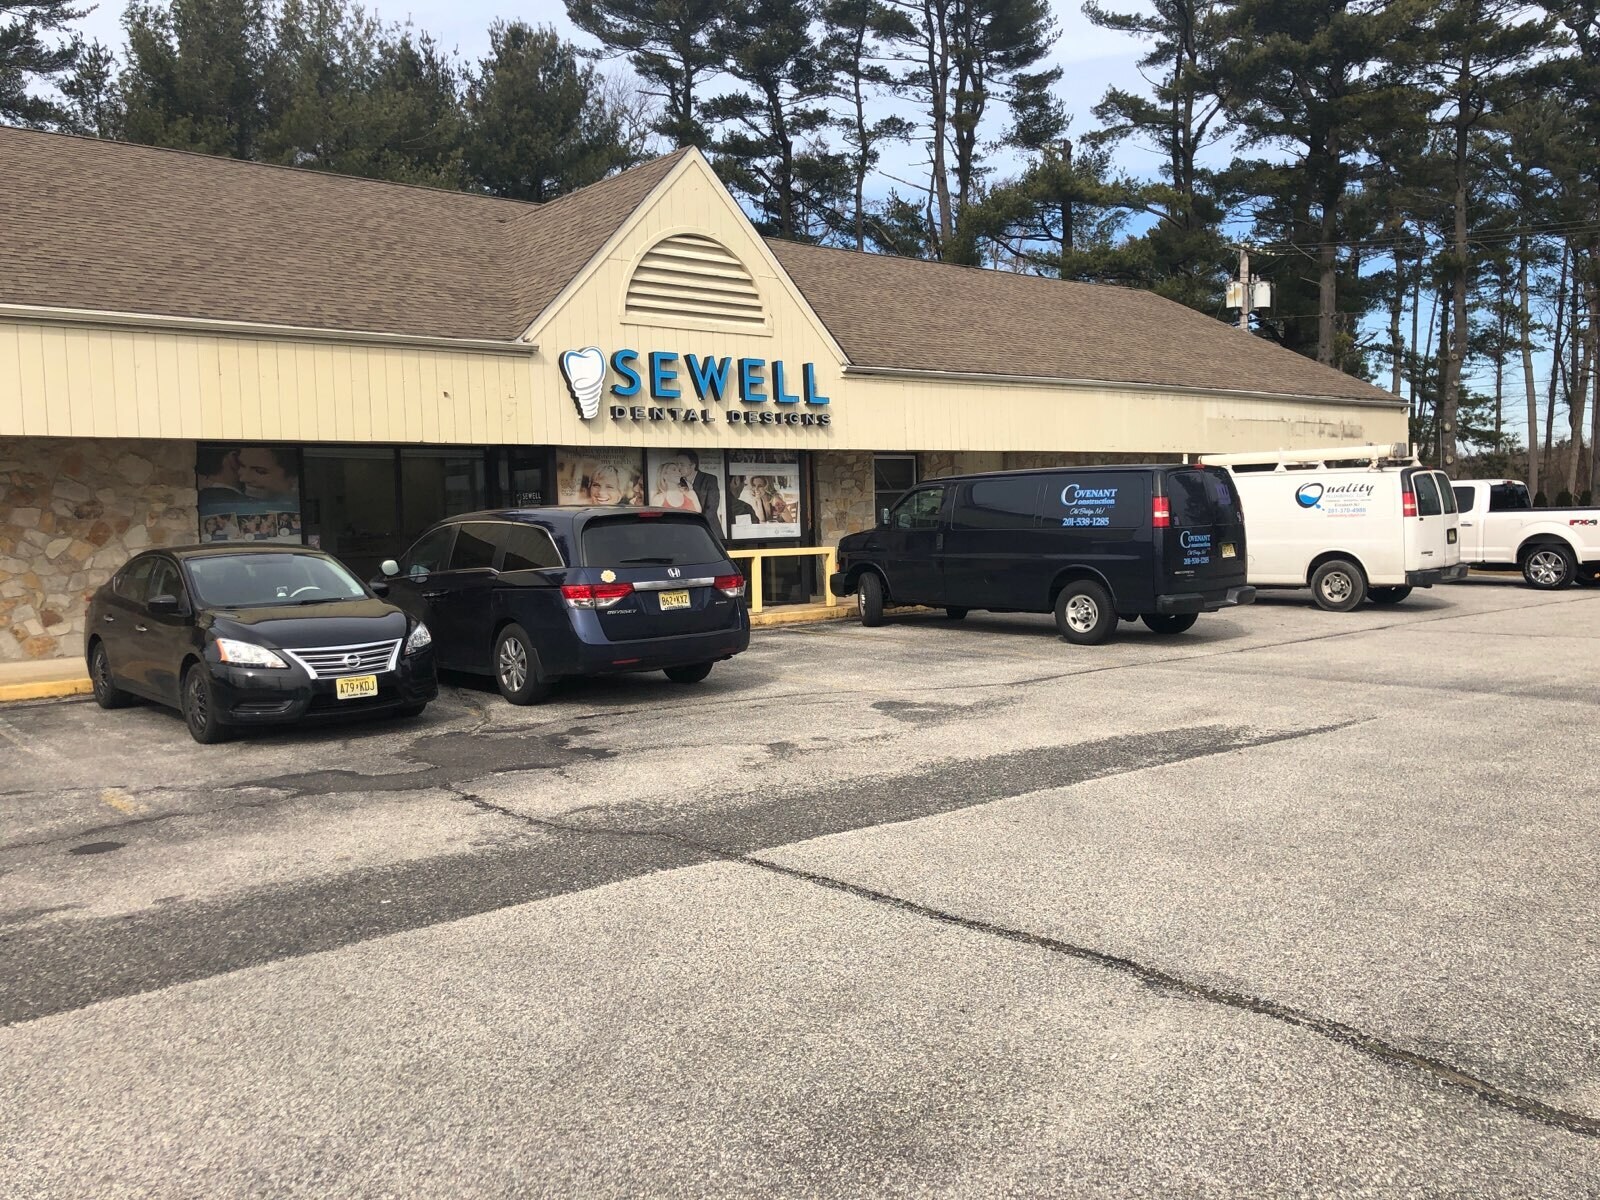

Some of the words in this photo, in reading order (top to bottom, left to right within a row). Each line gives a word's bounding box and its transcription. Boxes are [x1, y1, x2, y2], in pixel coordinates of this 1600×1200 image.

[610, 349, 830, 405] SEWELL
[610, 405, 715, 422] DENTAL
[726, 410, 831, 427] DESIGNS
[522, 492, 541, 500] SEWELL
[1060, 484, 1118, 506] COVENANT
[1062, 517, 1110, 527] 201-538-1285
